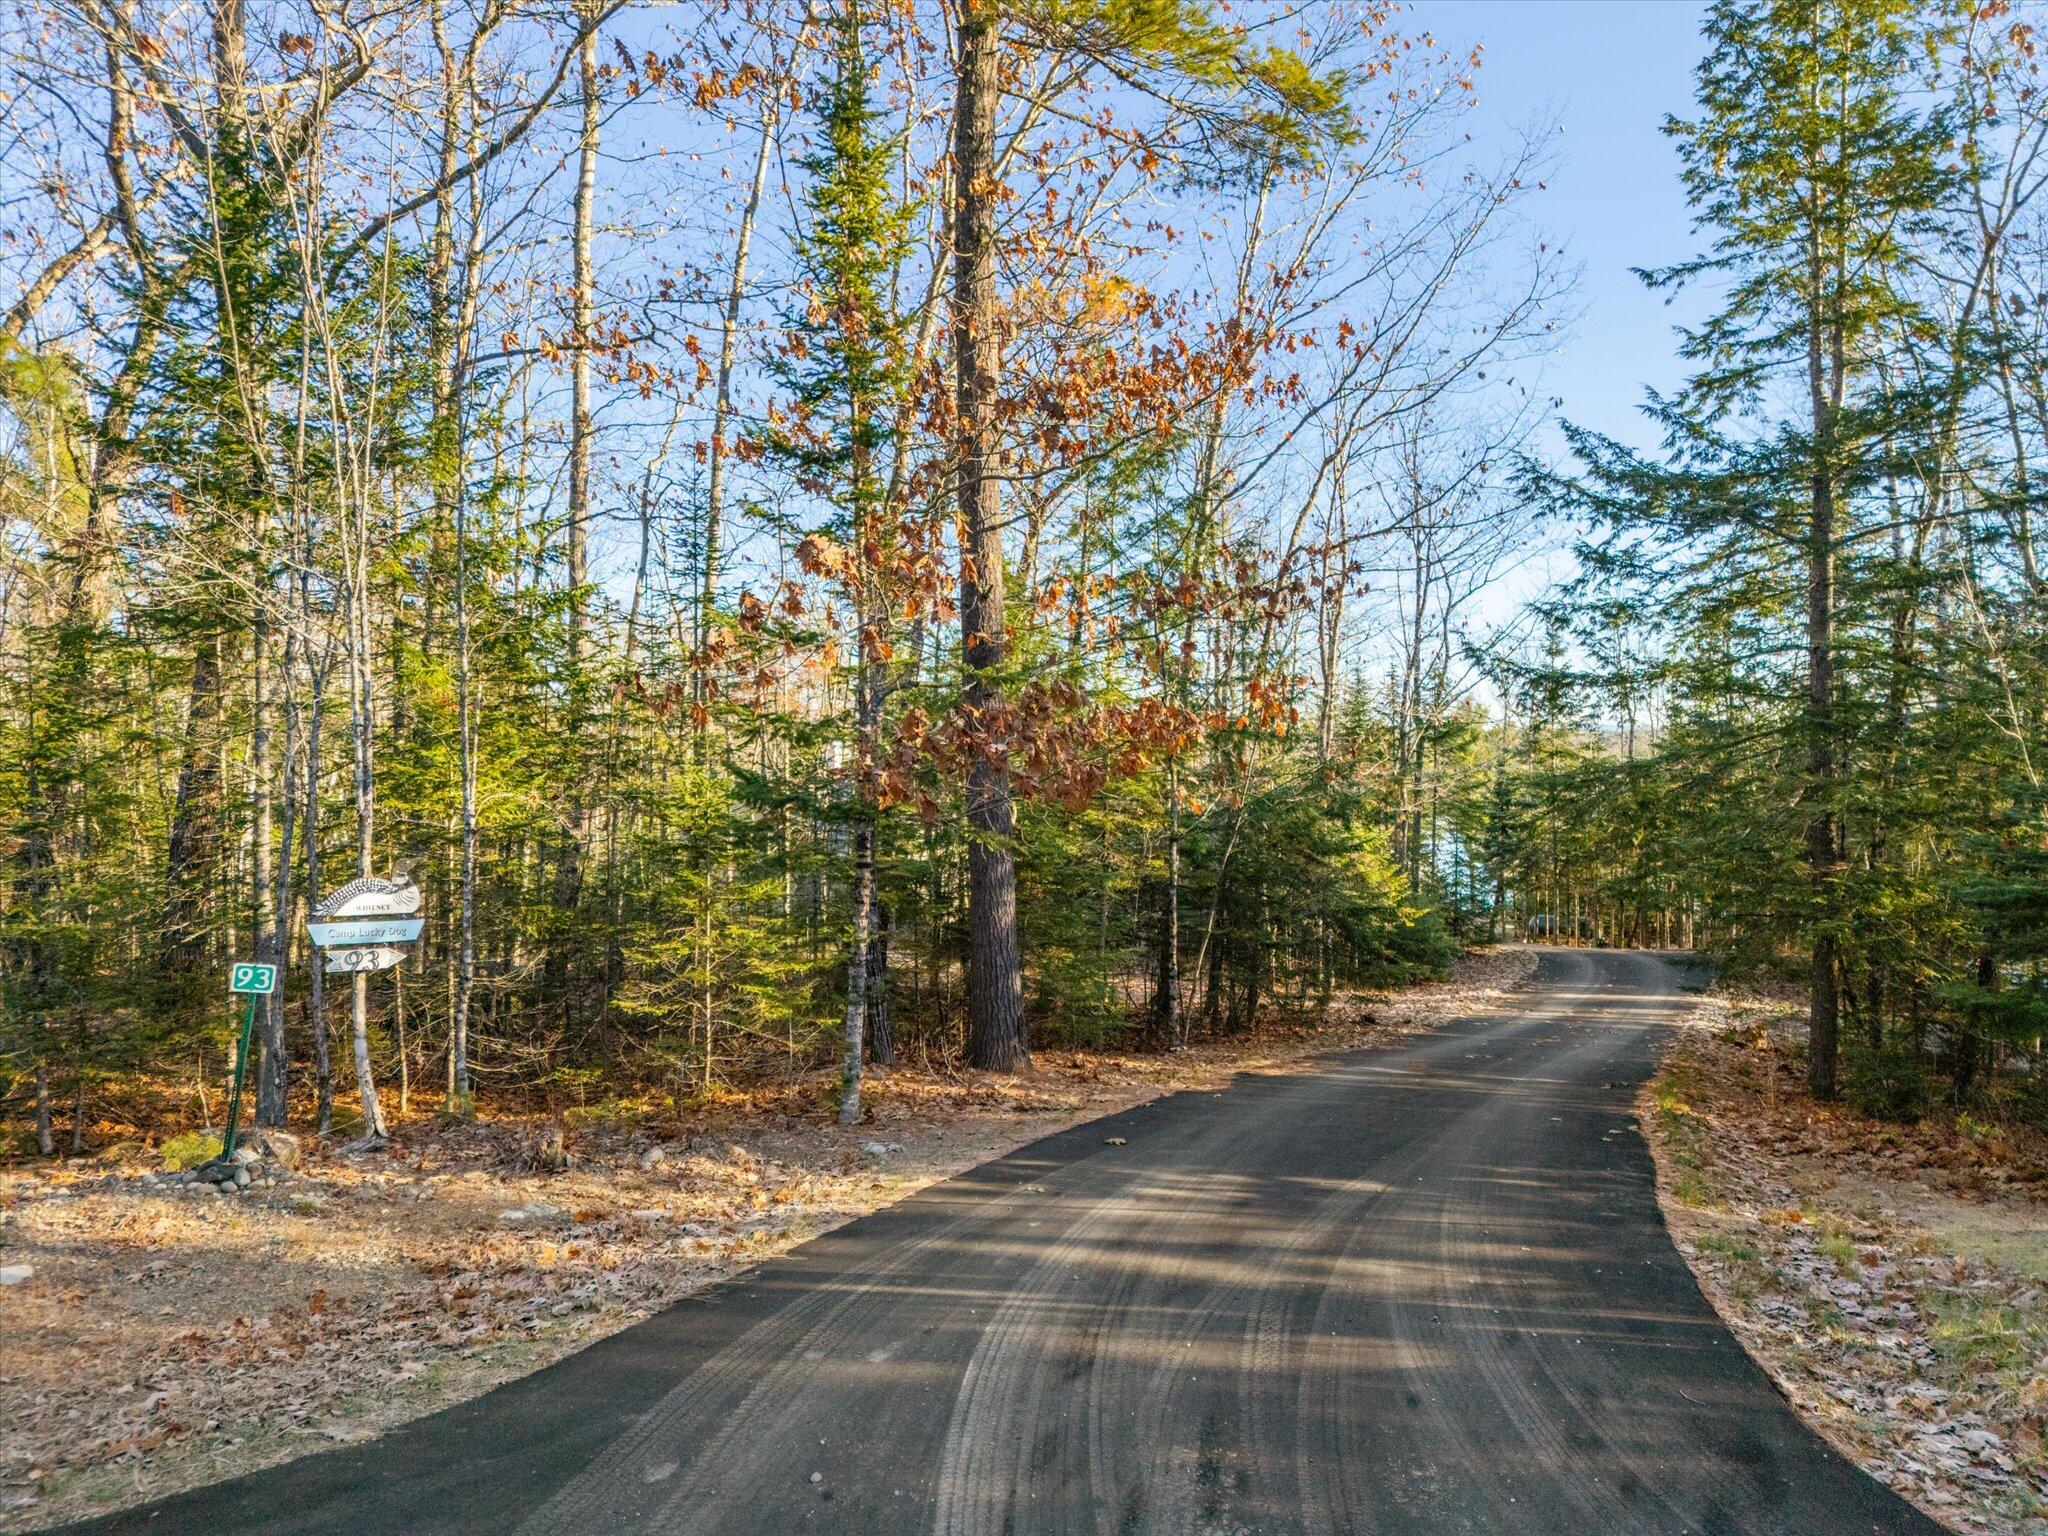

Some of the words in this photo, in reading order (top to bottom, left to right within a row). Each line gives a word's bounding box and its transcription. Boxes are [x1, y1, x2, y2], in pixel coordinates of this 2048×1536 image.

[328, 929, 356, 939] Camp
[359, 927, 386, 937] Lucky
[388, 927, 407, 937] Dog
[343, 950, 380, 971] 93
[236, 967, 271, 989] 93
